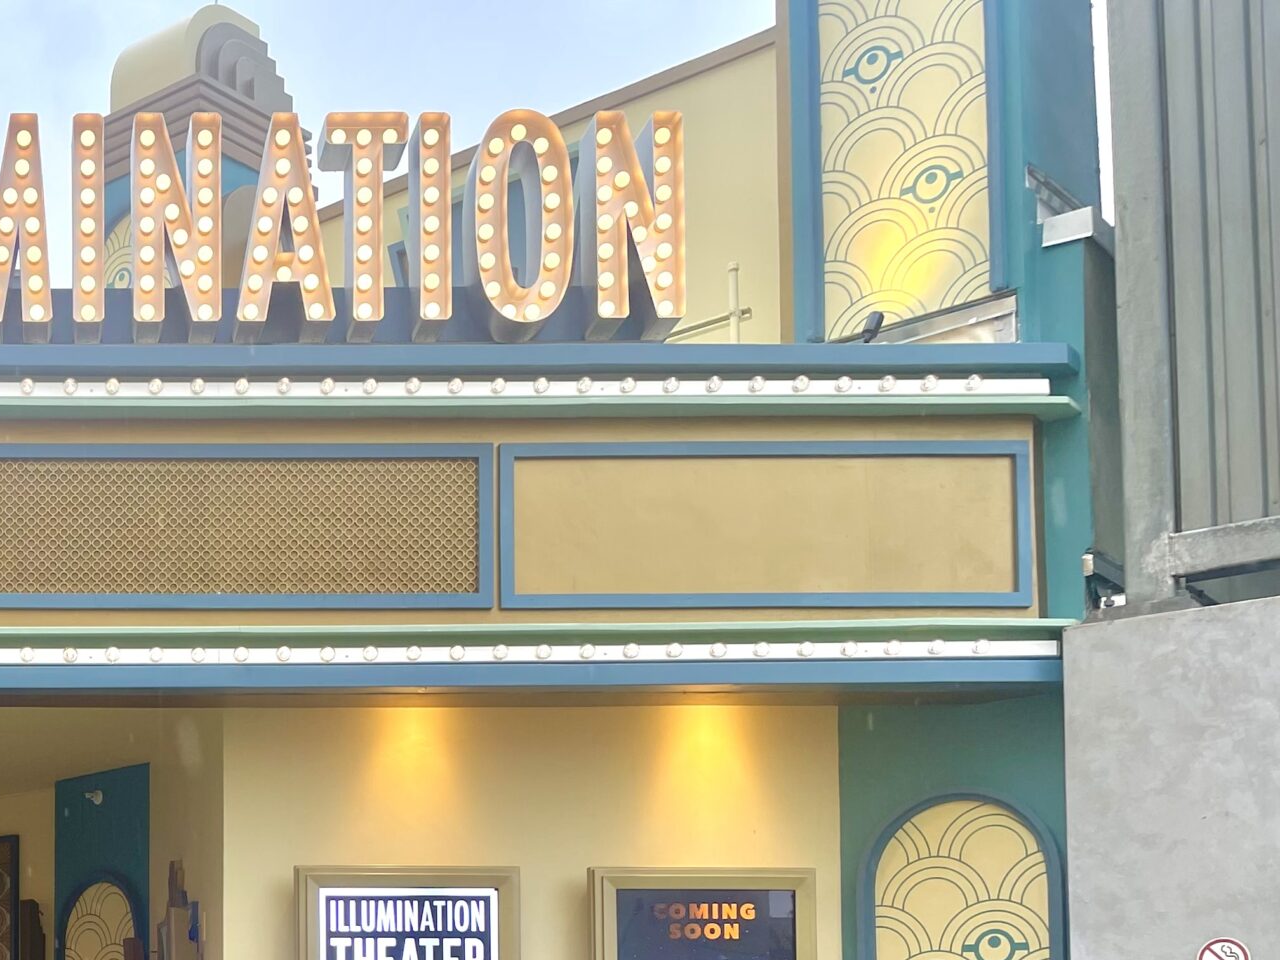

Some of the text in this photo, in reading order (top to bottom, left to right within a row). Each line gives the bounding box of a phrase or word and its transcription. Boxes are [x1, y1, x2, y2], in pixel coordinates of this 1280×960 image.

[329, 899, 486, 933] ILLUMINATION
[652, 902, 756, 920] COMING
[668, 922, 740, 940] SOON
